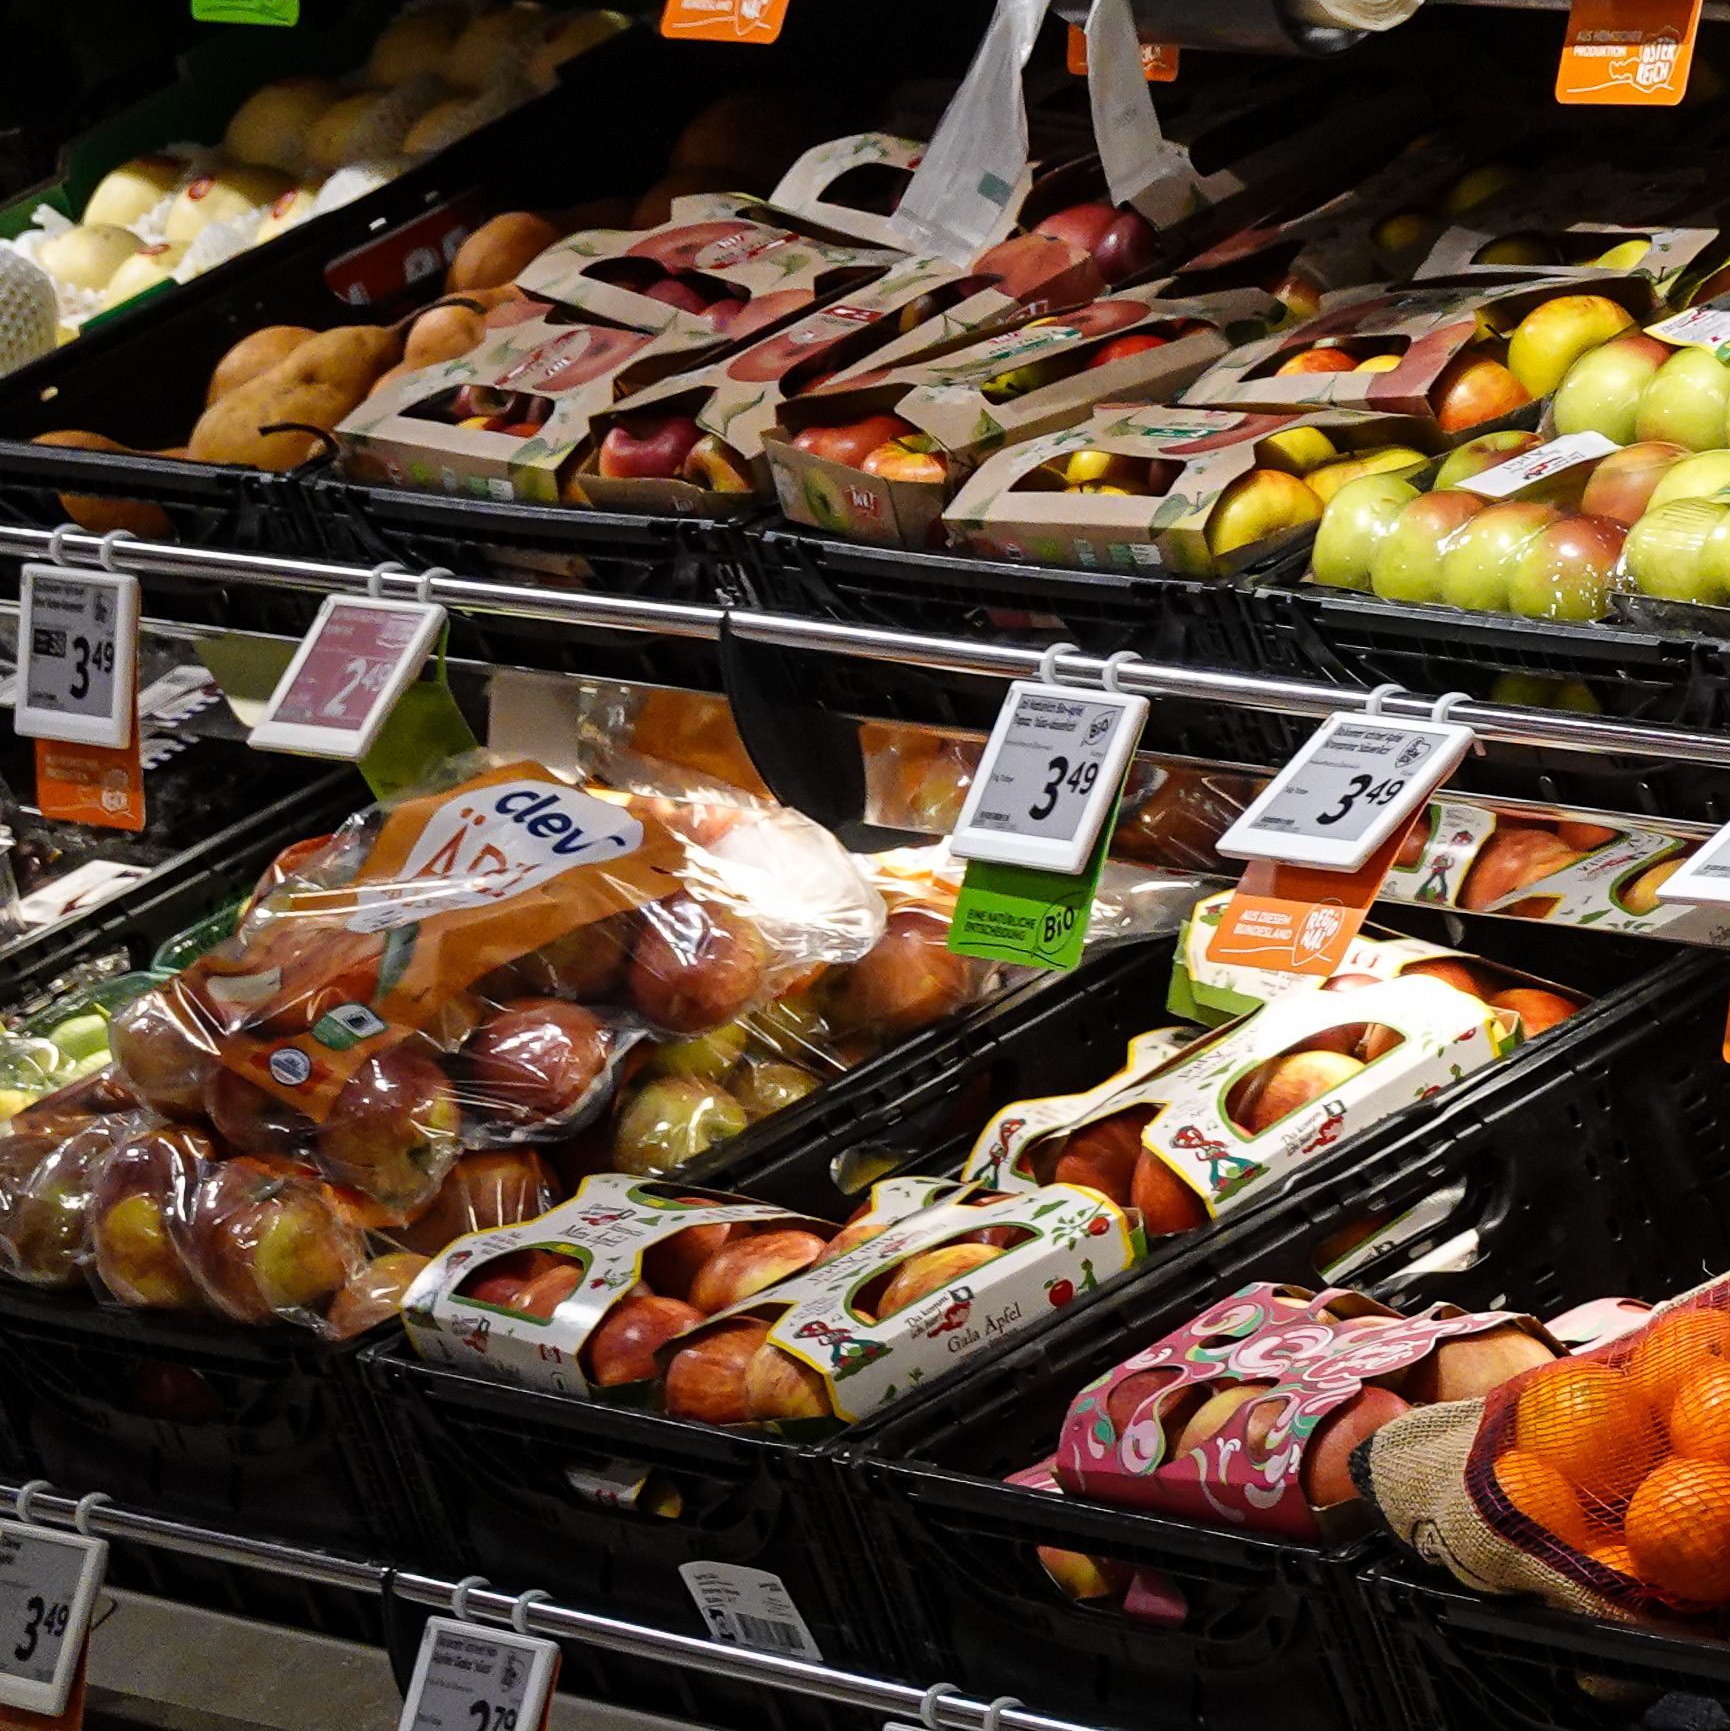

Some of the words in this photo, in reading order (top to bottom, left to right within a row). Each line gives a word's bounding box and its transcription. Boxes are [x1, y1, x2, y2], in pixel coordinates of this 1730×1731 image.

[1043, 907, 1075, 942] BiO
[946, 1326, 981, 1356] Gala
[984, 1301, 1023, 1338] Äpfel
